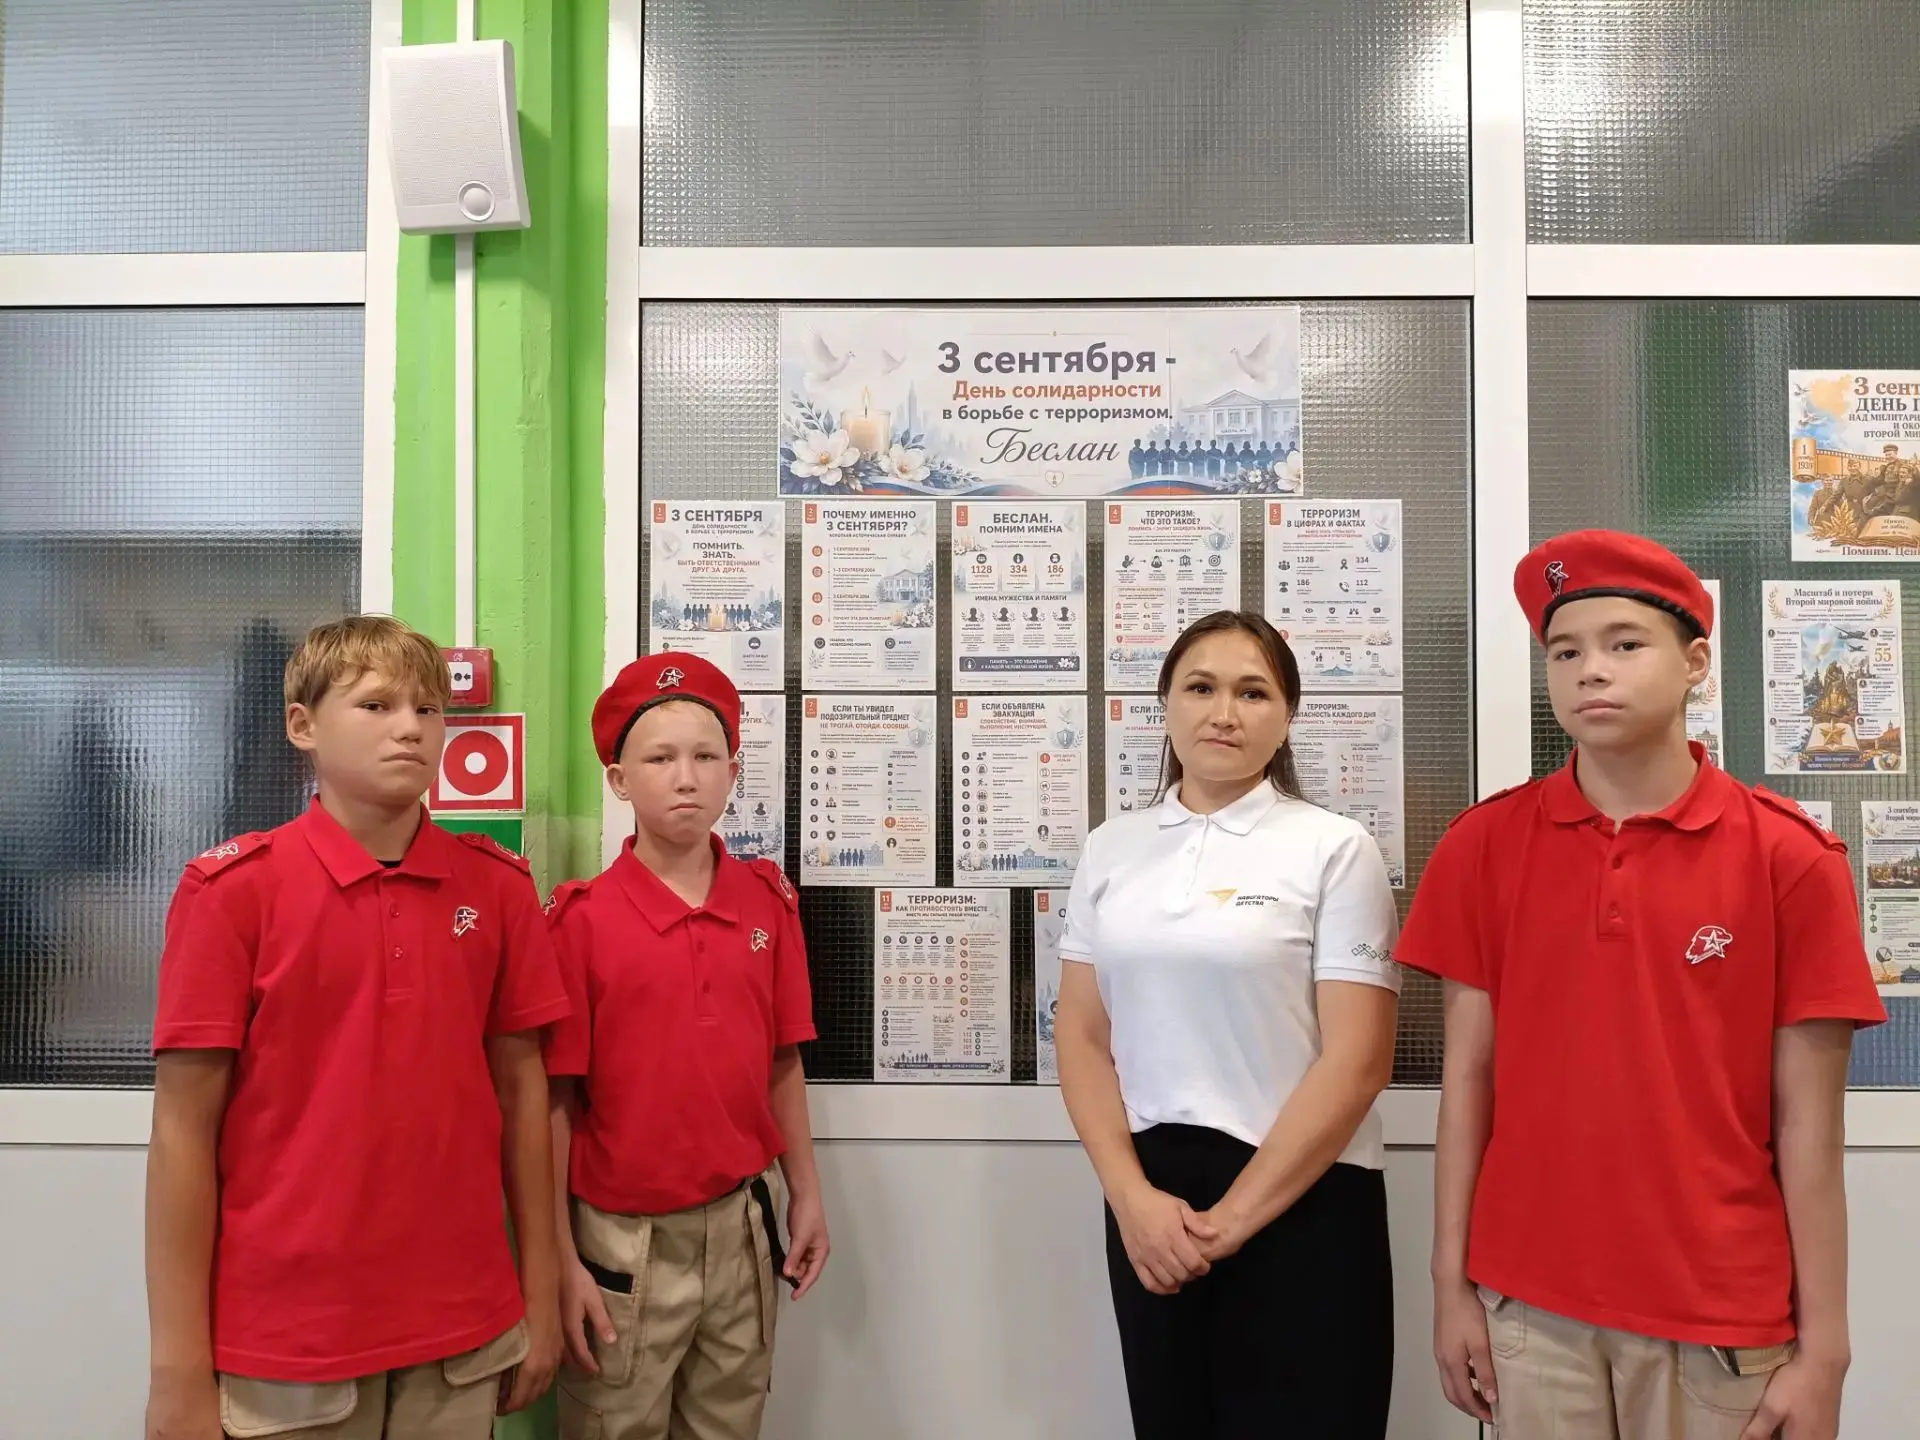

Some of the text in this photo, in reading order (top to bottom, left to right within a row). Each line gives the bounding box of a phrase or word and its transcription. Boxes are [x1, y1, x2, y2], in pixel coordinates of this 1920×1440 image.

[937, 341, 961, 374] 3
[974, 342, 1156, 380] сентября
[953, 380, 1161, 401] День солидарности
[1854, 376, 1869, 396] 3
[1856, 398, 1907, 413] ДЕНЬ
[943, 405, 1173, 423] в борьбе с терроризмом.
[1849, 414, 1868, 422] НАД
[1893, 422, 1899, 430] И
[1864, 430, 1901, 438] ВТОРОЙ
[980, 427, 1121, 464] Беслан
[671, 509, 763, 521] 3 СЕНТЯБРЯ
[823, 510, 917, 519] ПОЧЕМУ ИМЕННО
[1146, 510, 1195, 518] ТЕРРОРИЗМ:
[1301, 509, 1360, 518] ТЕРРОРИЗМ
[993, 513, 1053, 524] БЕСЛАН.
[826, 521, 908, 531] 3 СЕНТЯБРЯ?
[1287, 520, 1292, 528] В
[1294, 520, 1326, 528] ЦИФРАХ
[1335, 520, 1366, 528] ФАКТАХ
[980, 525, 1063, 534] ПОМНИМ ИМЕНА
[693, 542, 744, 550] ПОМНИТЬ.
[702, 551, 736, 559] ЗНАТЬ.
[1842, 546, 1891, 556] Помним.
[971, 565, 1064, 574] 1128 334 186
[1794, 588, 1832, 597] Масштаб
[1842, 590, 1873, 599] потери
[1785, 597, 1883, 606] Второй мировой войны
[1874, 647, 1892, 663] 55
[832, 704, 895, 713] ЕСЛИ ТЫ УВИДЕЛ
[1130, 706, 1151, 714] ЕСЛИ
[1306, 703, 1350, 711] ТЕРРОРИЗМ:
[820, 713, 910, 721] ПОДОЗРИТЕЛЬНЫЙ ПРЕДМЕТ
[993, 710, 1035, 718] ЭВАКУАЦИЯ
[1893, 806, 1918, 814] сентября
[1885, 814, 1905, 822] Второй
[908, 895, 977, 904] ТЕРРОРИЗМ:
